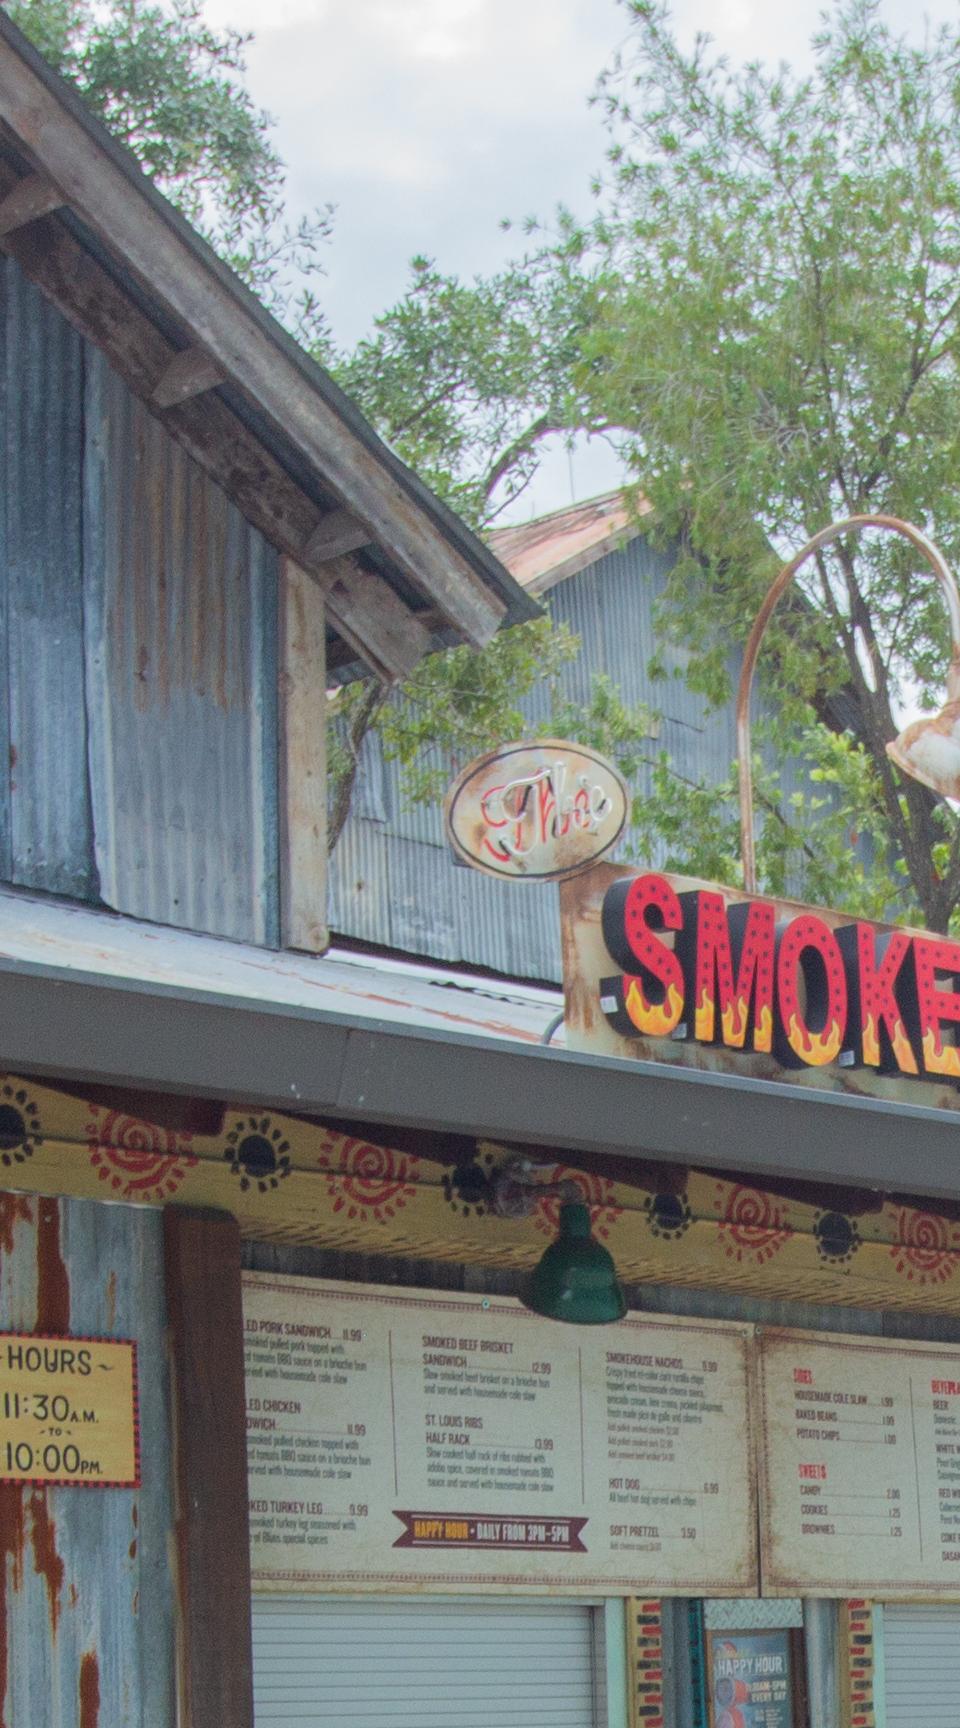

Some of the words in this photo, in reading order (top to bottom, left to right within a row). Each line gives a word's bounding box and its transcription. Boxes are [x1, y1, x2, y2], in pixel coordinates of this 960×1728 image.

[259, 1320, 282, 1334] PORK
[284, 1322, 330, 1338] SANDWICH
[342, 1327, 361, 1341] 11.99
[422, 1335, 456, 1350] SMOKED
[458, 1338, 477, 1351] BEEF
[480, 1340, 513, 1354] BRISKET
[7, 1345, 91, 1376] HOURS
[422, 1353, 467, 1368] SANDWICH
[531, 1361, 551, 1374] 12.99
[606, 1351, 653, 1367] SMOKEHOUSE
[654, 1355, 682, 1369] NACHOS
[794, 1390, 831, 1403] HOUSEMADE
[833, 1392, 848, 1404] COLE
[850, 1394, 867, 1405] SLAW
[932, 1399, 948, 1410] BEER
[263, 1399, 300, 1414] CHICKEN
[438, 1414, 462, 1428] LOUIS
[464, 1416, 483, 1429] RIBS
[795, 1409, 815, 1421] BAKED
[817, 1410, 837, 1422] BEANS
[347, 1423, 366, 1436] 11.99
[796, 1428, 819, 1440] POTATO
[821, 1429, 839, 1441] CHIPS
[425, 1431, 446, 1444] HALF
[448, 1432, 470, 1445] RACK
[935, 1443, 954, 1453] WHITE
[798, 1463, 826, 1479] SWEETS
[608, 1477, 622, 1489] HOT
[624, 1478, 639, 1490] DOG
[799, 1483, 820, 1495] CANDY
[270, 1500, 304, 1513] TURKEY
[306, 1502, 322, 1514] LEG
[801, 1503, 827, 1515] COOKIES
[414, 1521, 444, 1538] HAPPY
[445, 1522, 468, 1539] HOUR
[476, 1523, 499, 1540] DAILY
[502, 1524, 525, 1541] FROM
[609, 1523, 627, 1536] SOFT
[629, 1524, 659, 1537] PRETZEL
[801, 1522, 834, 1534] BROWNIES
[941, 1532, 955, 1543] COKE
[718, 1658, 753, 1675] HAPPY
[755, 1656, 783, 1673] HOUR
